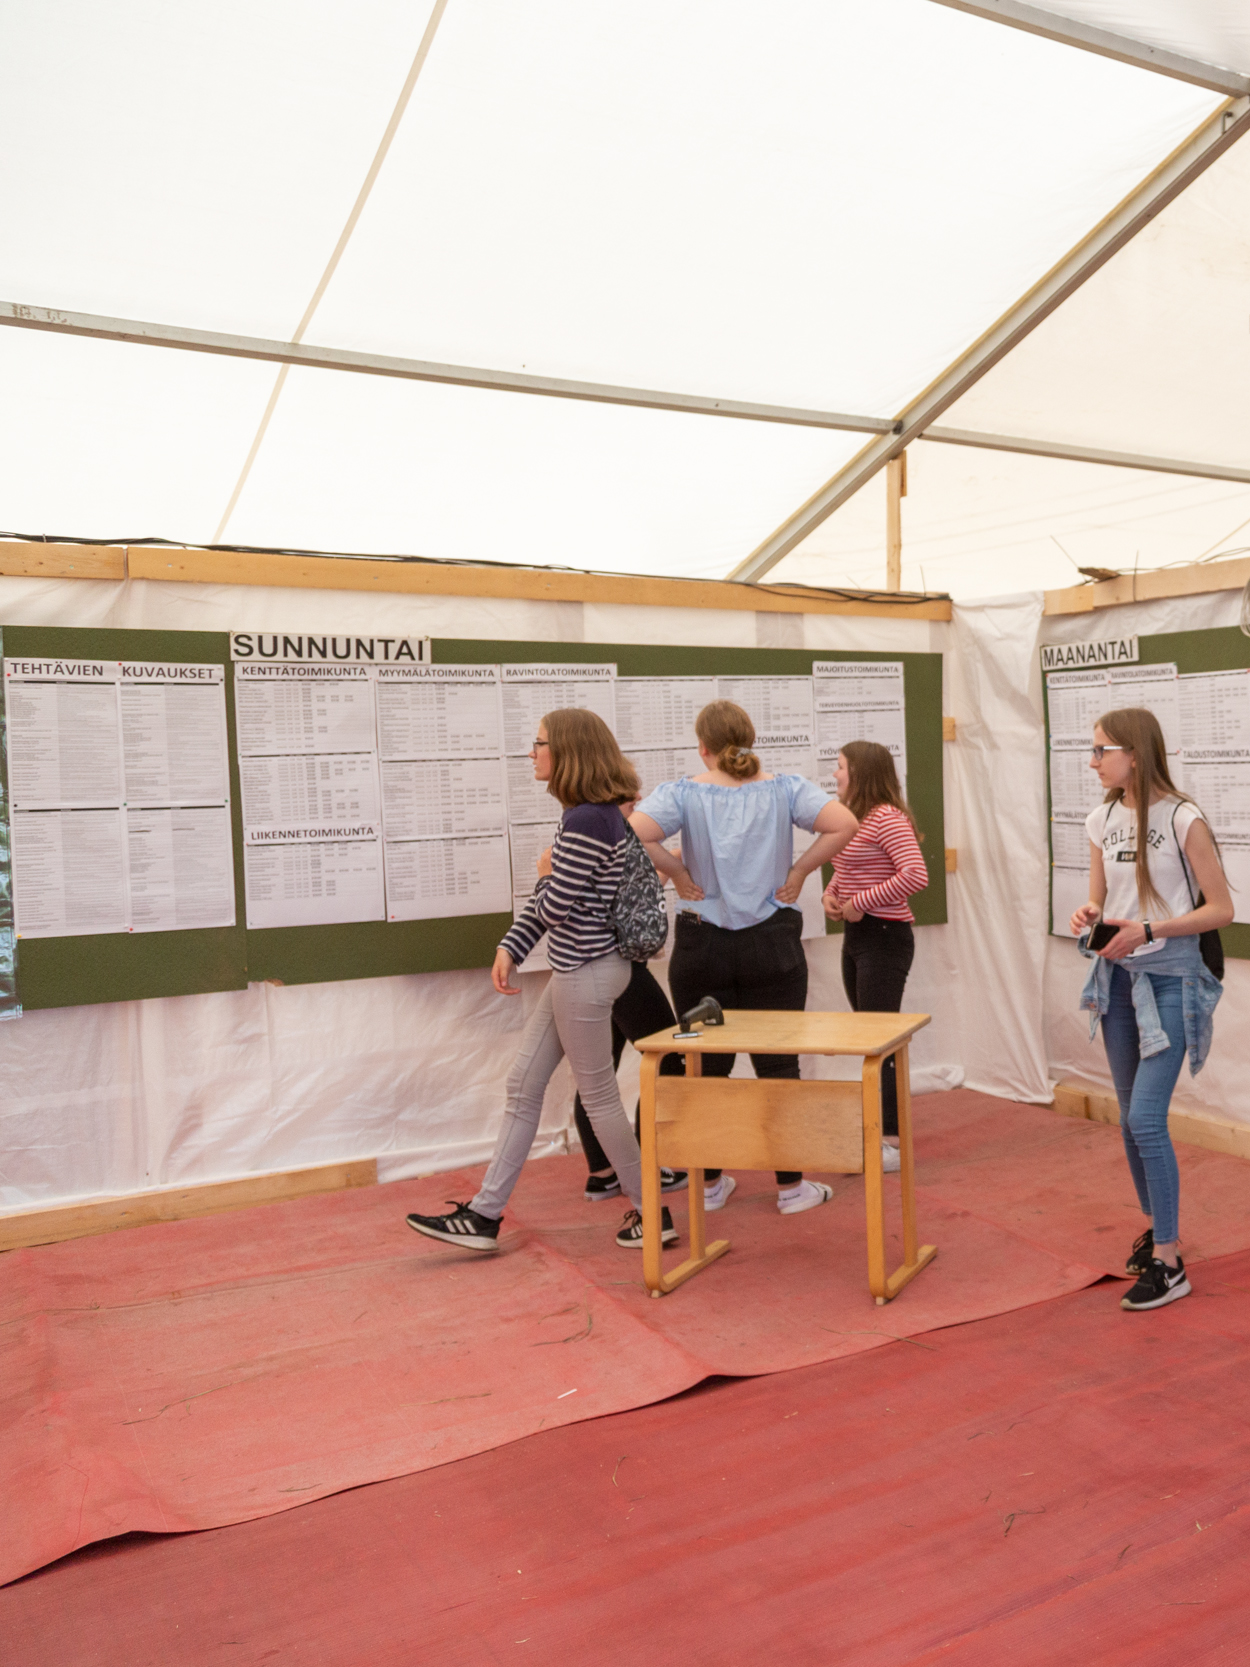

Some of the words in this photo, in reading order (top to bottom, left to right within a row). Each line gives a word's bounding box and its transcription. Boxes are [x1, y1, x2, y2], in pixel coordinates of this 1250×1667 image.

[233, 633, 424, 662] SUNNUNTAI
[1043, 638, 1134, 669] MAANANTAI
[10, 660, 104, 677] TEHTÄVIEN
[121, 665, 215, 680] KUVAUKSET
[242, 664, 367, 677] KENTTÄTOIMIKUNTA
[378, 667, 495, 678] MYYMÄLÄTOIMIKUNTA
[505, 667, 612, 677] RAVINTOLATOIMIKUNTA
[816, 665, 899, 674] MAJOITUSTOIMIKUNTA
[250, 826, 375, 841] LIIKENNETOIMIKUNTA
[1102, 826, 1166, 851] COLLGE
